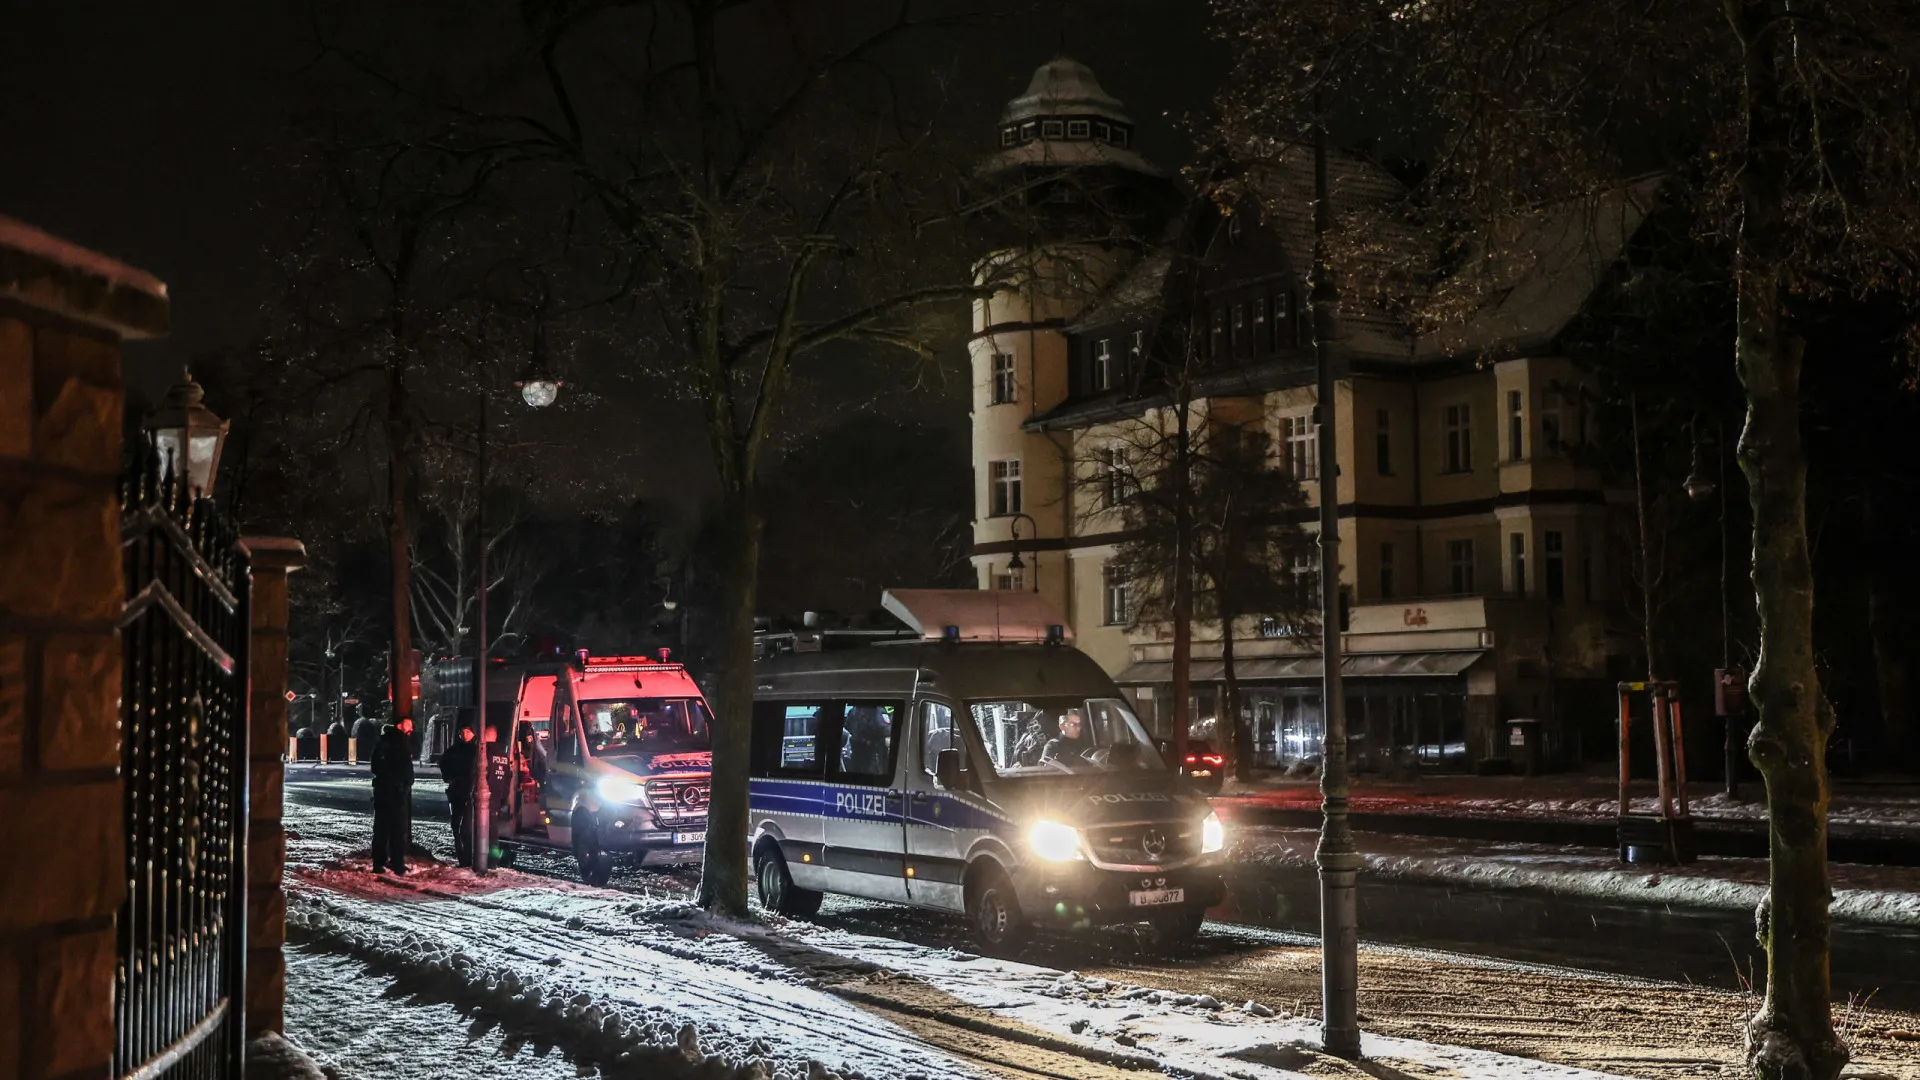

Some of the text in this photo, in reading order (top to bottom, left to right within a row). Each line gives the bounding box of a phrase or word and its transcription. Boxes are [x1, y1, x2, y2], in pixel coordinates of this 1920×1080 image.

[836, 792, 886, 817] POLIZEI
[1088, 792, 1169, 806] POLIZEI
[681, 834, 686, 842] B
